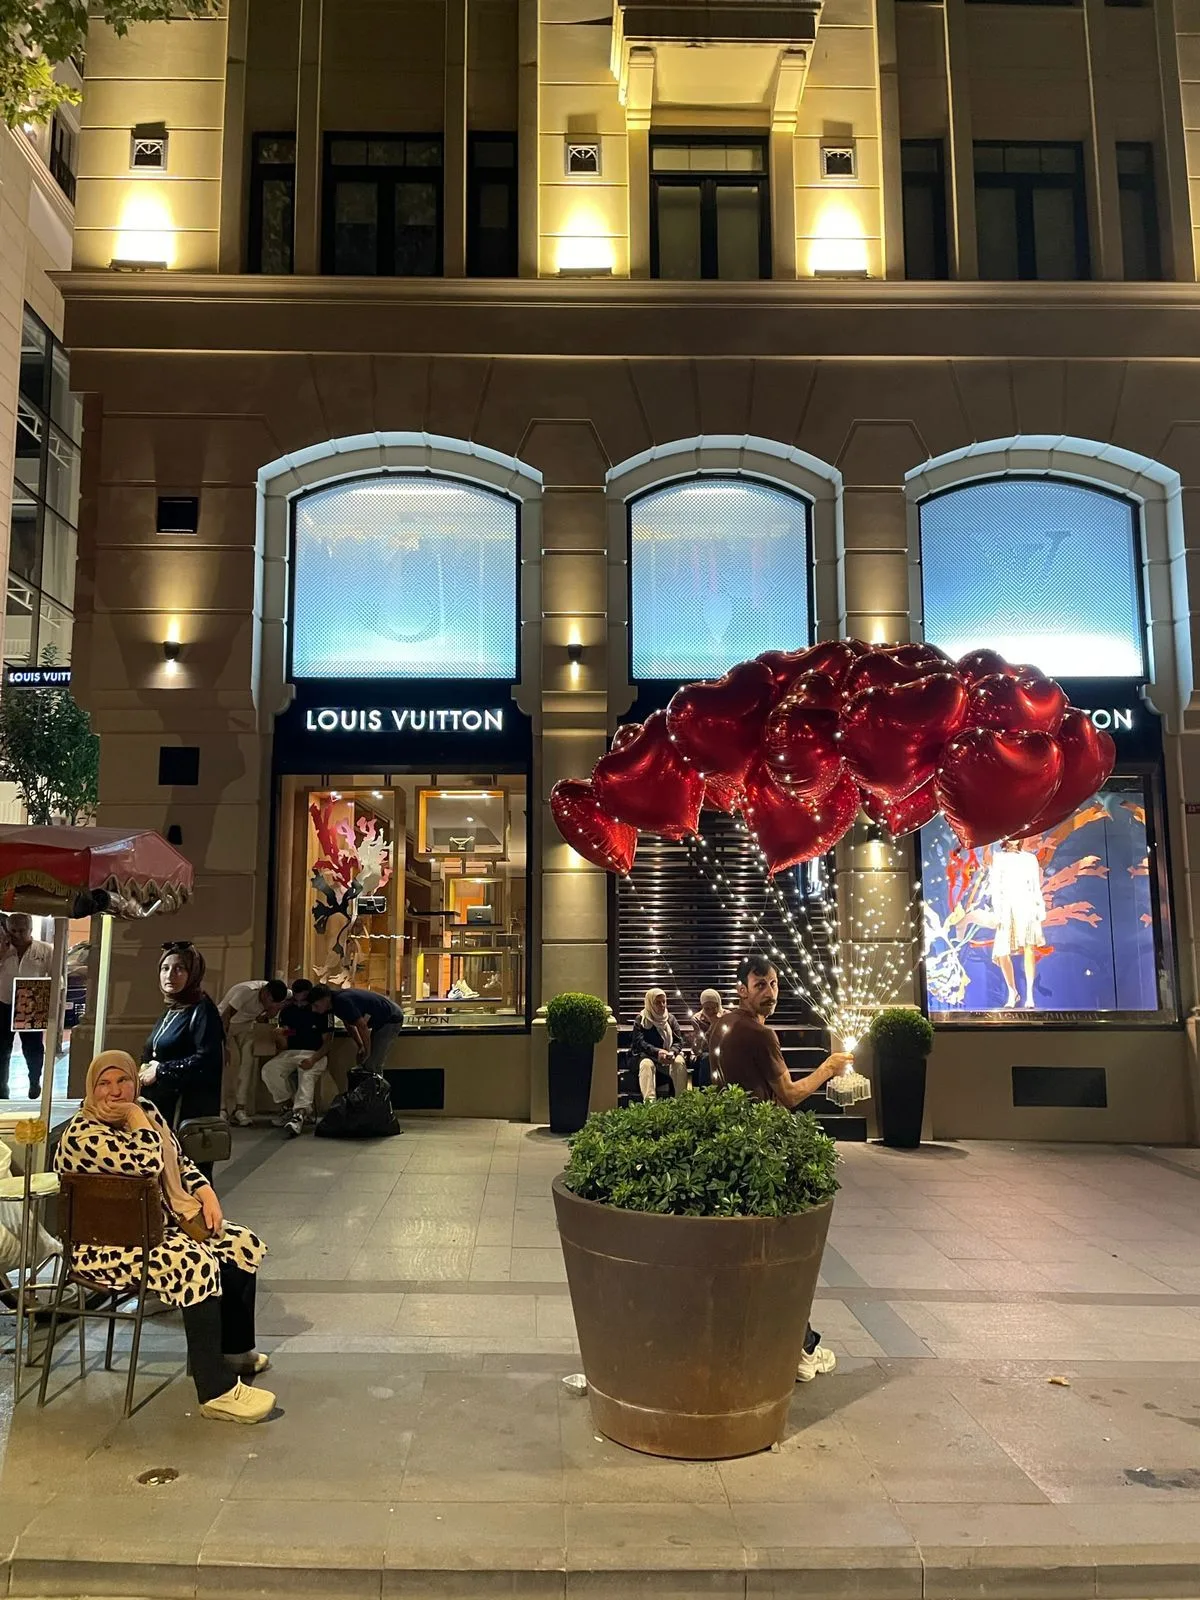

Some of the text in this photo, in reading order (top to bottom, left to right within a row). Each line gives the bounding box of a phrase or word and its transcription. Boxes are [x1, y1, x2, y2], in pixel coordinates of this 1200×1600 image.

[9, 672, 41, 682] LOUIS
[306, 709, 503, 731] LOUIS VUITTON
